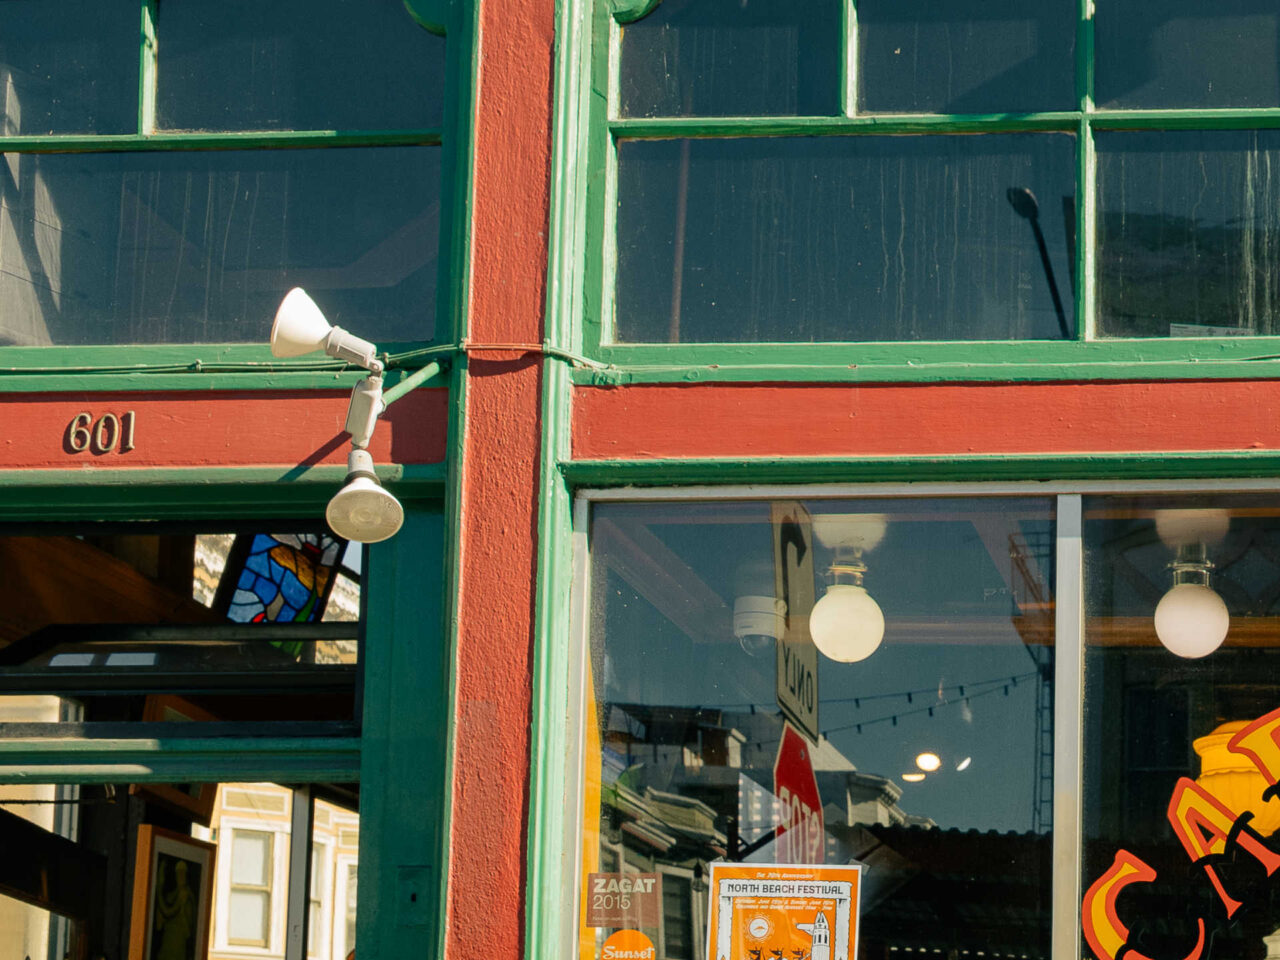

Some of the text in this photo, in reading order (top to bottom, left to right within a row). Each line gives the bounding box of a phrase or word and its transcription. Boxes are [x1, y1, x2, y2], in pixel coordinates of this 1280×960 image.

[68, 409, 136, 453] 601
[593, 878, 656, 893] ZAGAT
[727, 883, 844, 895] NORTH BEACH FESTIVAL
[592, 894, 632, 910] 2015
[602, 945, 656, 960] Sunset
